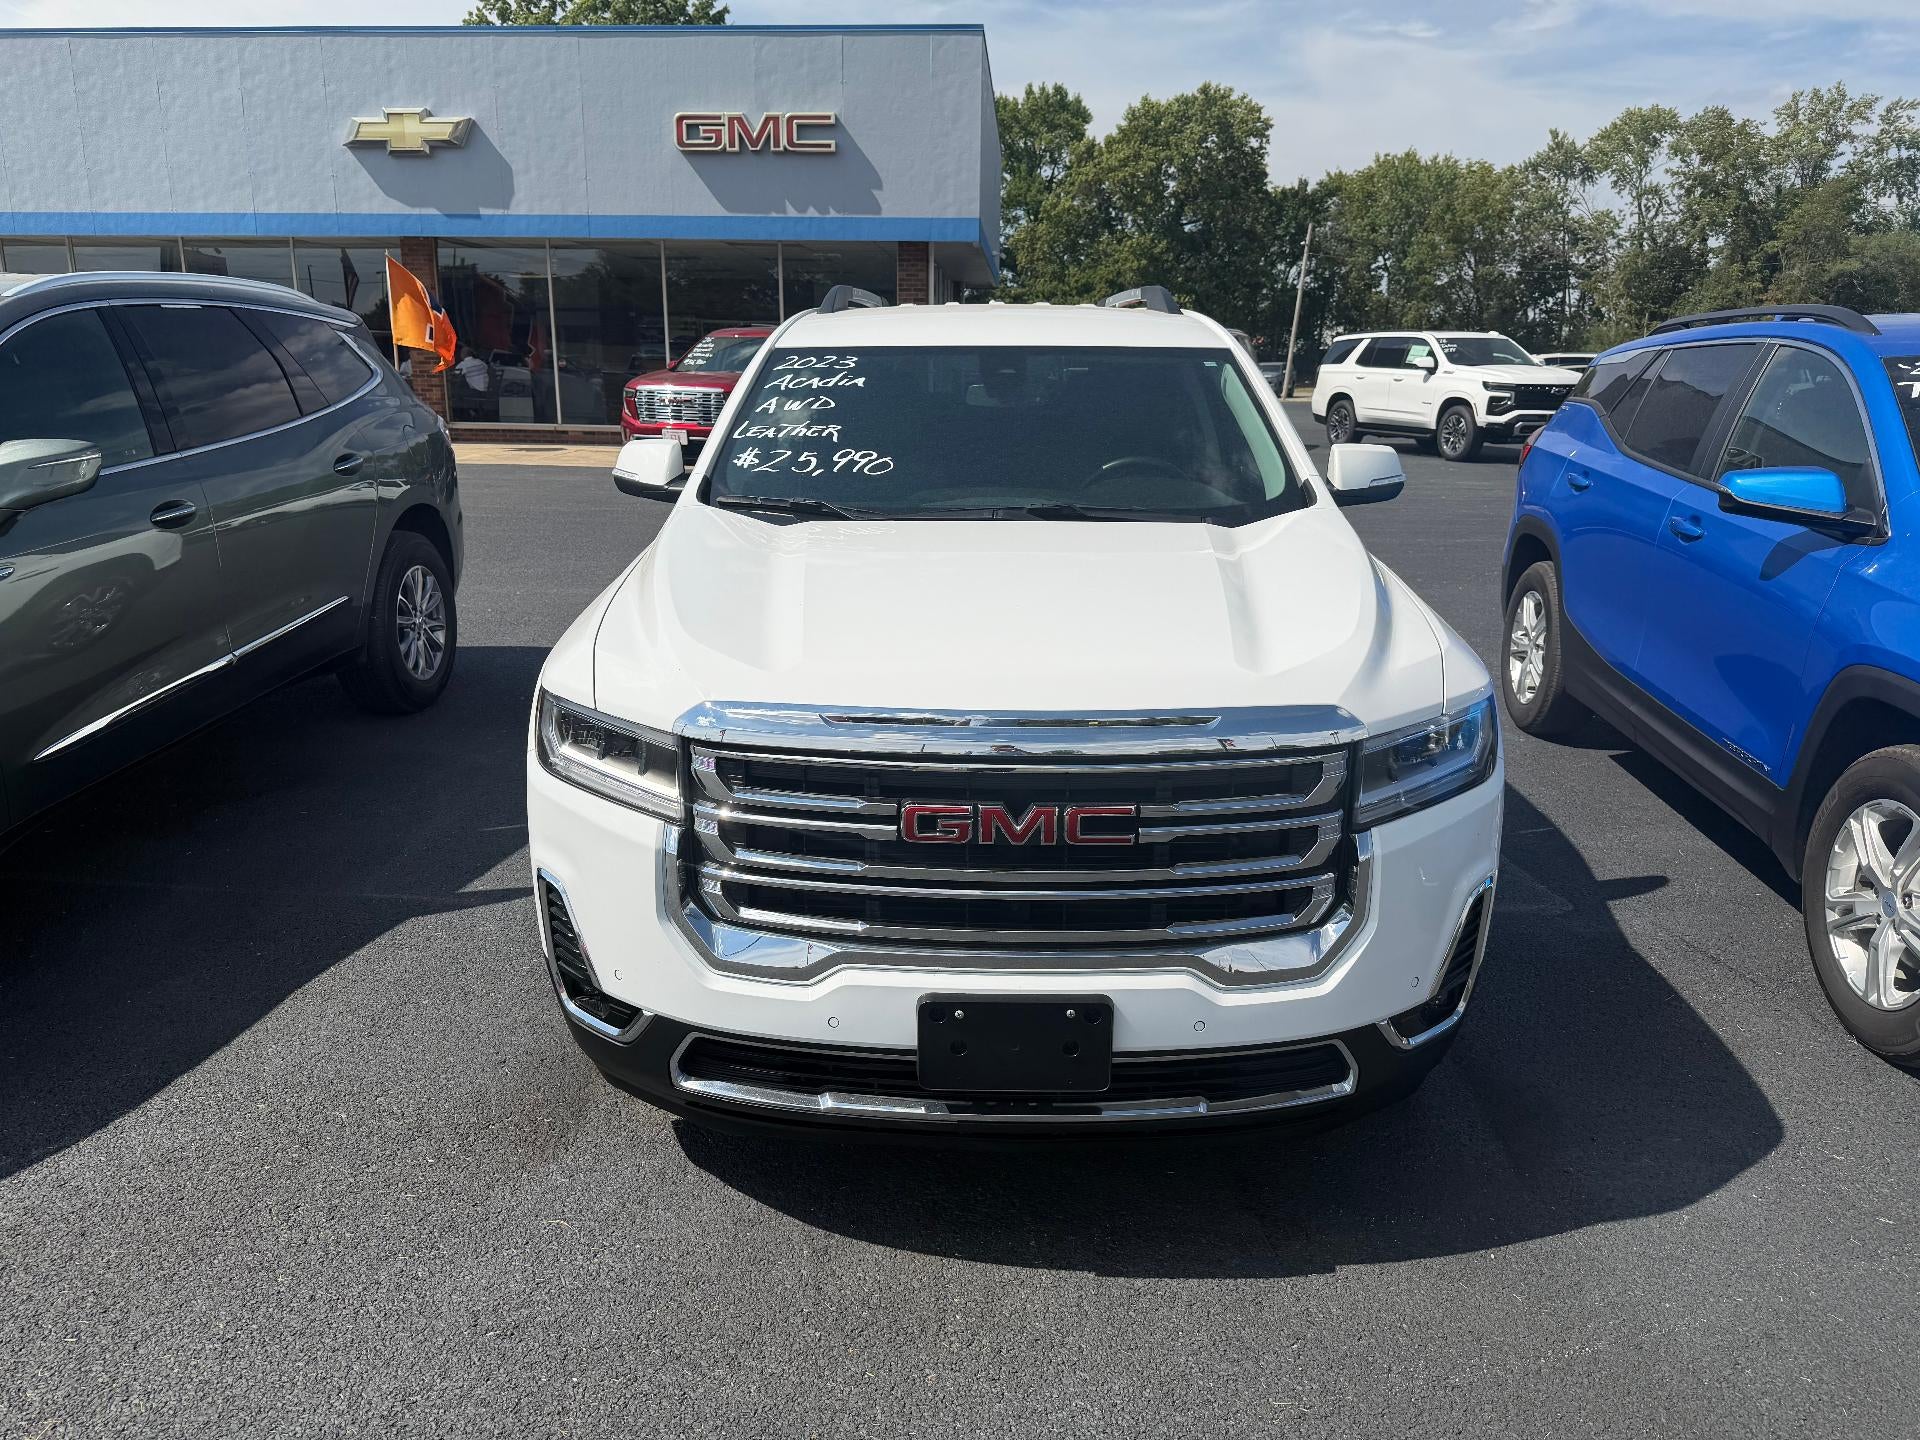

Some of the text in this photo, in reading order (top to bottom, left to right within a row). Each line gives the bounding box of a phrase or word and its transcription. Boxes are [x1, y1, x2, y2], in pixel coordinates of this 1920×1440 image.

[673, 111, 836, 152] GMC
[773, 355, 858, 371] 2023
[732, 447, 894, 477] $25,990
[900, 802, 1137, 845] GMC
